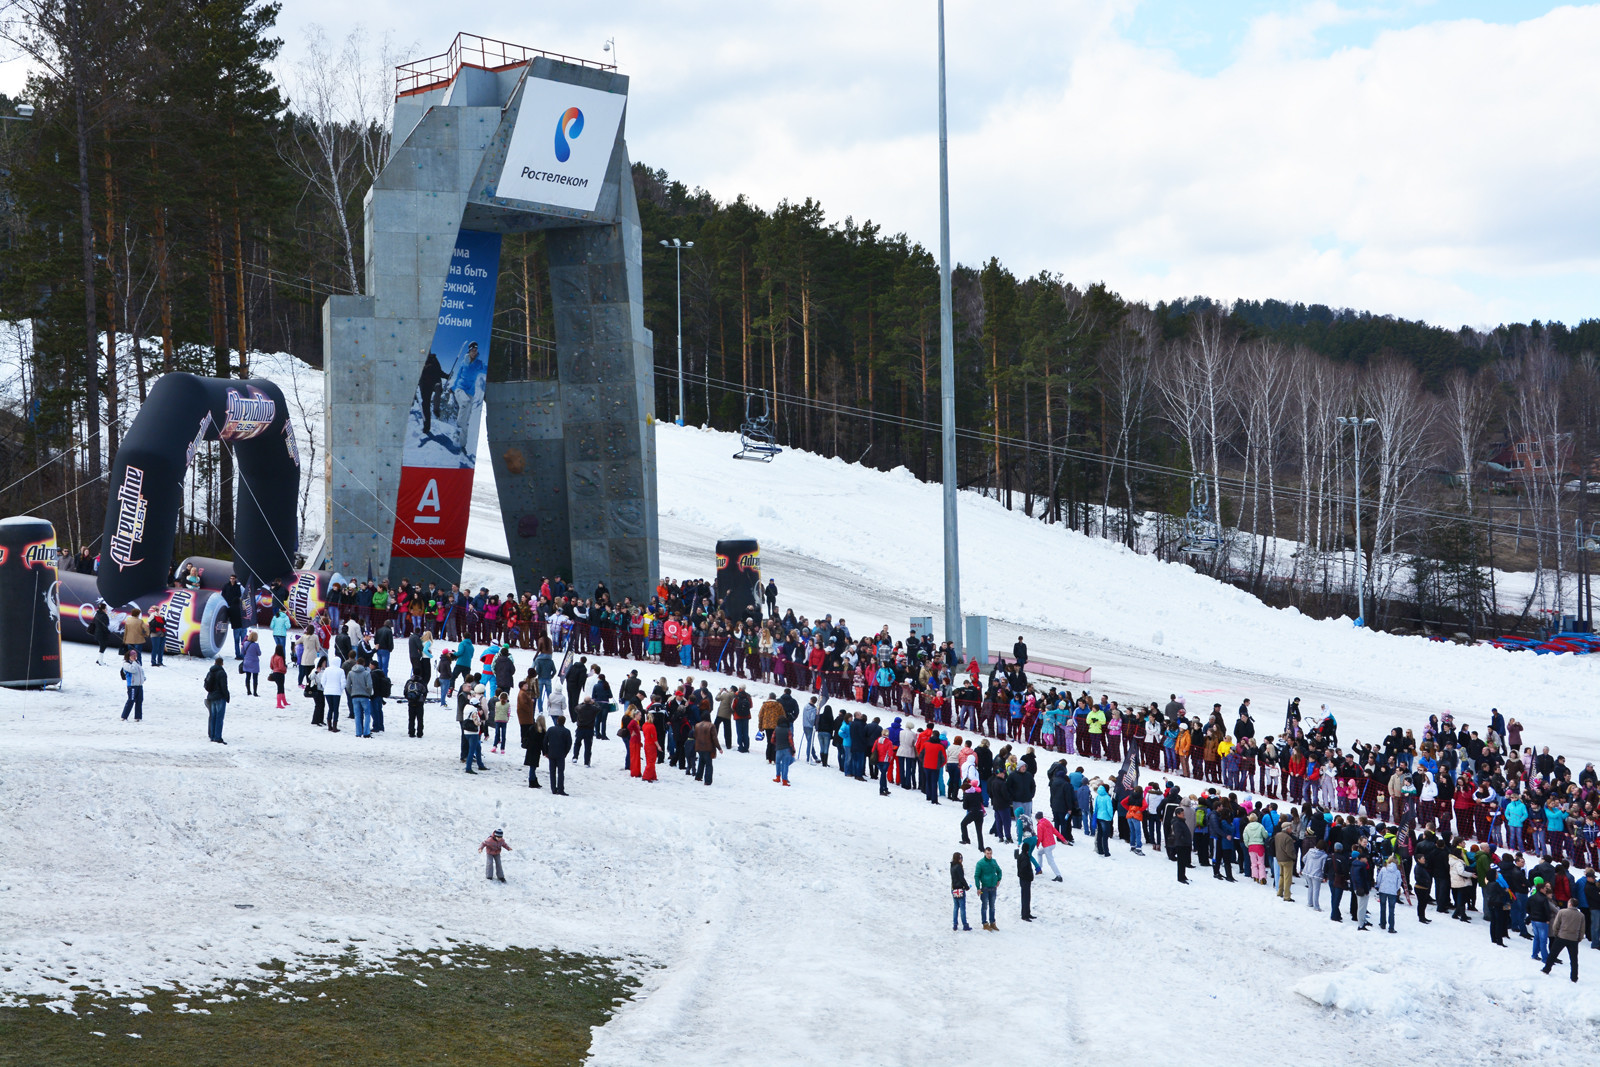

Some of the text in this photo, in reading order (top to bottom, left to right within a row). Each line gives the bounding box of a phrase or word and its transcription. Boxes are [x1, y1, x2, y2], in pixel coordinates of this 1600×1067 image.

[521, 166, 588, 188] Ростелеком
[464, 264, 488, 278] быть
[441, 296, 465, 309] банк
[438, 313, 472, 328] обным
[227, 391, 275, 424] Adrenaline
[236, 423, 257, 432] RUSH
[110, 465, 144, 572] Adrenaline
[134, 499, 148, 542] RUSH
[400, 535, 446, 546] Альфа-Банк
